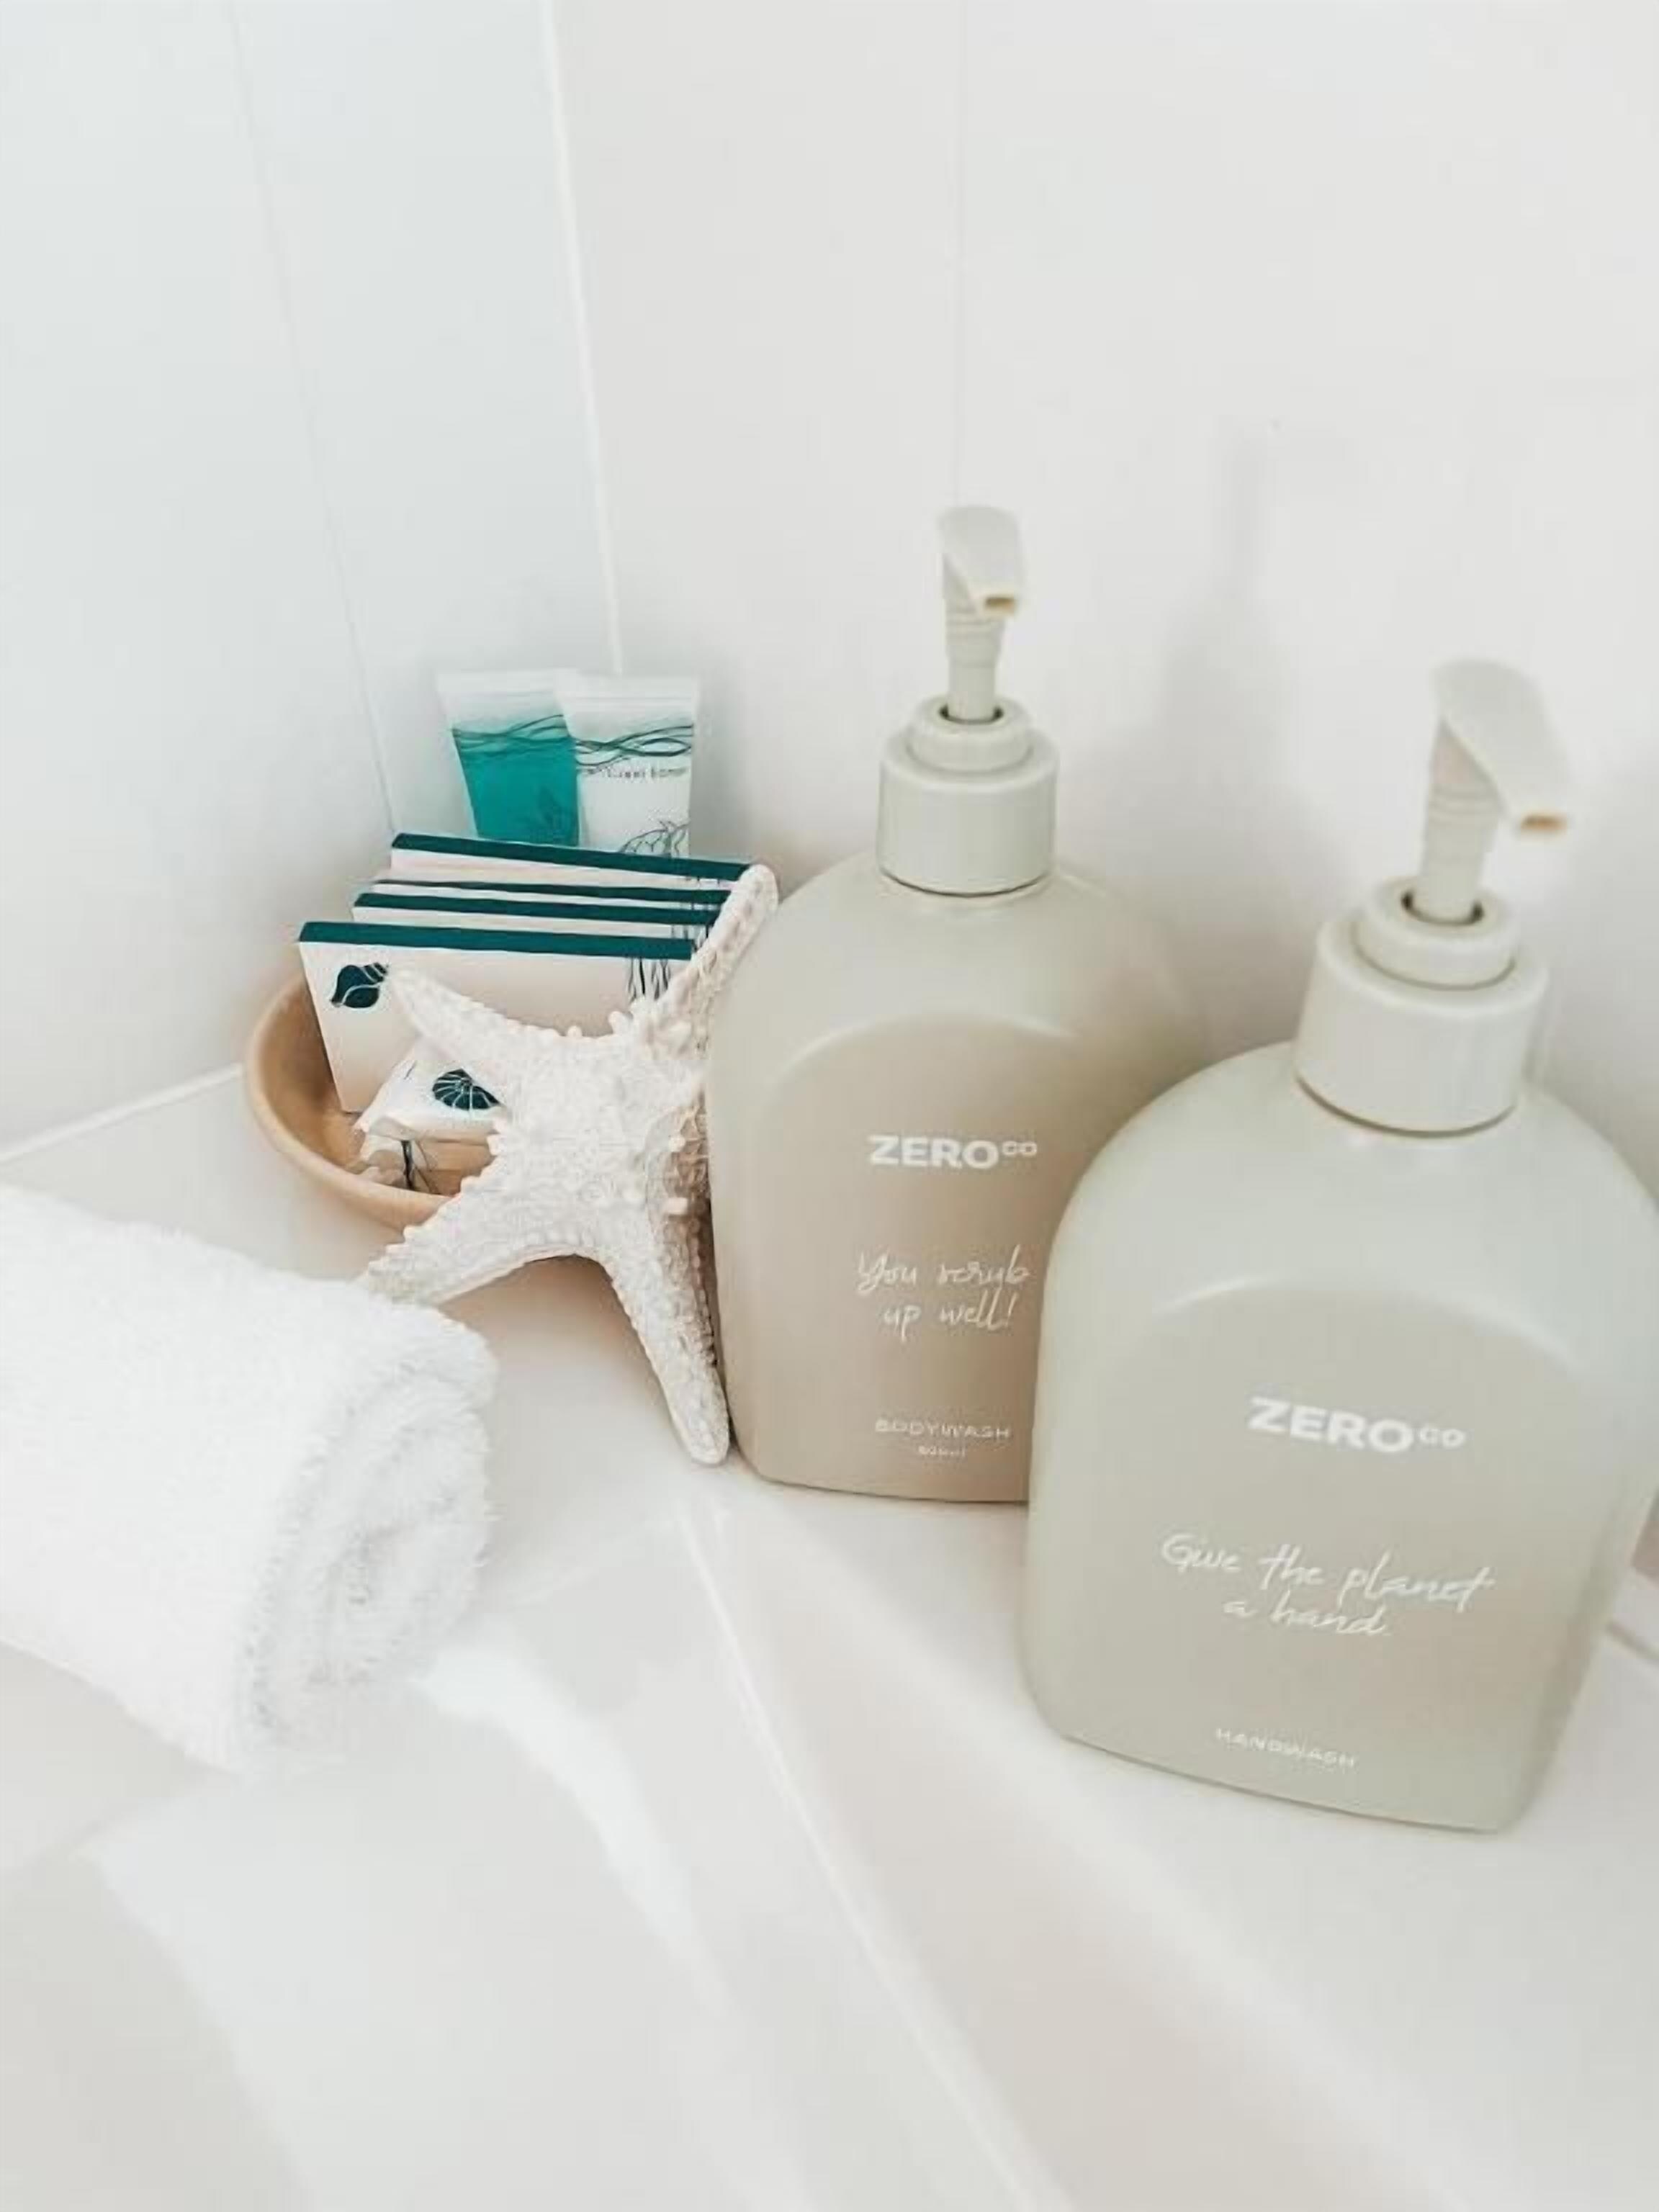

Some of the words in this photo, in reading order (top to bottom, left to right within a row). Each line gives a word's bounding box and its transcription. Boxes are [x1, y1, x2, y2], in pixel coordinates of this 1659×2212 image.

[857, 1251, 918, 1295] You
[938, 1244, 1030, 1289] scrub
[882, 1305, 921, 1343] up
[939, 1290, 1019, 1330] well!
[874, 1419, 1012, 1439] BODYWASH
[1161, 1533, 1241, 1573] Give
[1257, 1544, 1326, 1590] the
[1336, 1550, 1498, 1613] planet
[1224, 1600, 1258, 1618] a
[1215, 1727, 1355, 1767] HANDWASH
